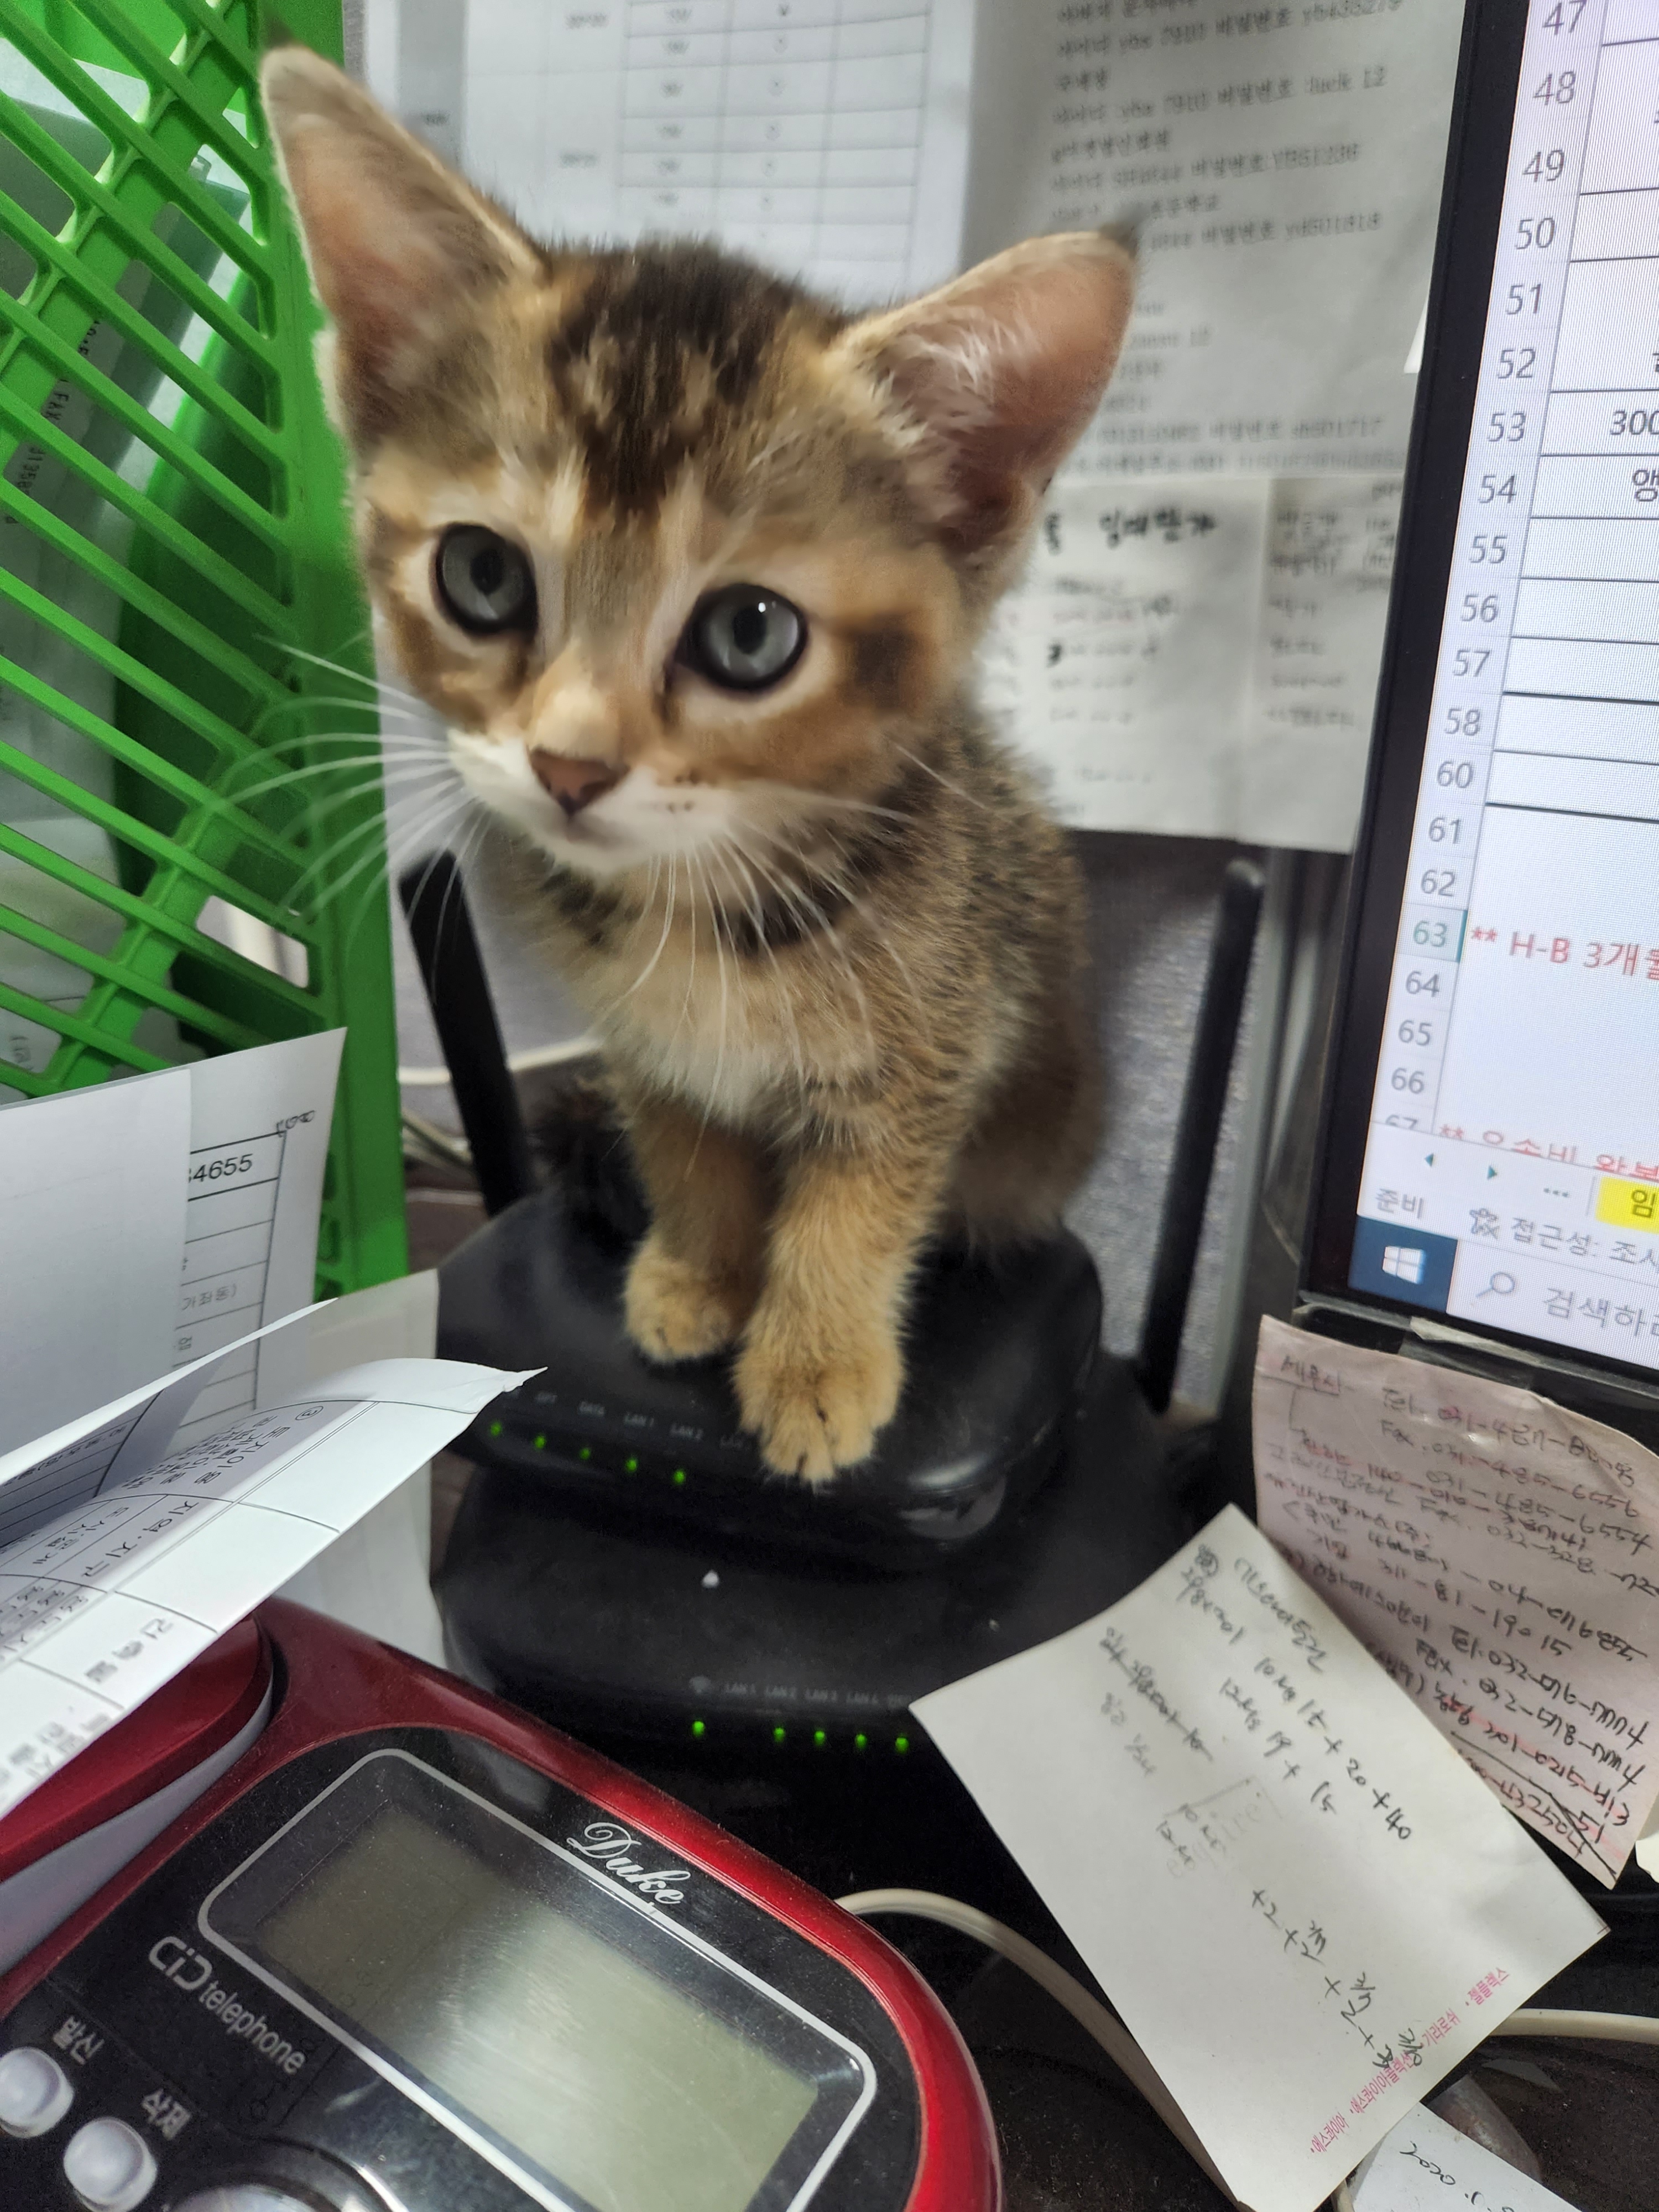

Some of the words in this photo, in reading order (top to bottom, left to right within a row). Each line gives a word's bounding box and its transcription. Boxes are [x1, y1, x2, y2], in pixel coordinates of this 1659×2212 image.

[1542, 0, 1587, 35] 47
[1533, 71, 1576, 106] 48
[1522, 149, 1565, 182] 49
[1515, 217, 1556, 250] 50
[1506, 283, 1542, 315] 51
[1497, 348, 1536, 379] 52
[1486, 412, 1526, 442] 53
[1477, 474, 1516, 504] 54
[1469, 535, 1508, 565] 55
[1460, 593, 1499, 623] 56
[1453, 648, 1491, 677] 57
[1444, 707, 1481, 736] 58
[1437, 760, 1474, 789] 60
[1428, 817, 1462, 844] 61
[1420, 869, 1456, 897] 62
[1413, 920, 1448, 948] 63
[1509, 931, 1570, 964] H-B
[1405, 969, 1441, 998] 64
[1398, 1019, 1432, 1046] 65
[1390, 1067, 1426, 1095] 66
[187, 1153, 254, 1184] 4655
[1375, 1188, 1425, 1219] 준비
[1510, 1218, 1598, 1258] 접근성:
[1543, 1287, 1659, 1337] 검색하
[194, 1426, 291, 1484] 토지이용
[567, 1821, 691, 1906] Duke
[1468, 1966, 1510, 2006] 젤플렉스
[51, 2014, 106, 2067] 발신
[199, 1980, 307, 2076] telephone
[140, 2086, 192, 2141] 삭제
